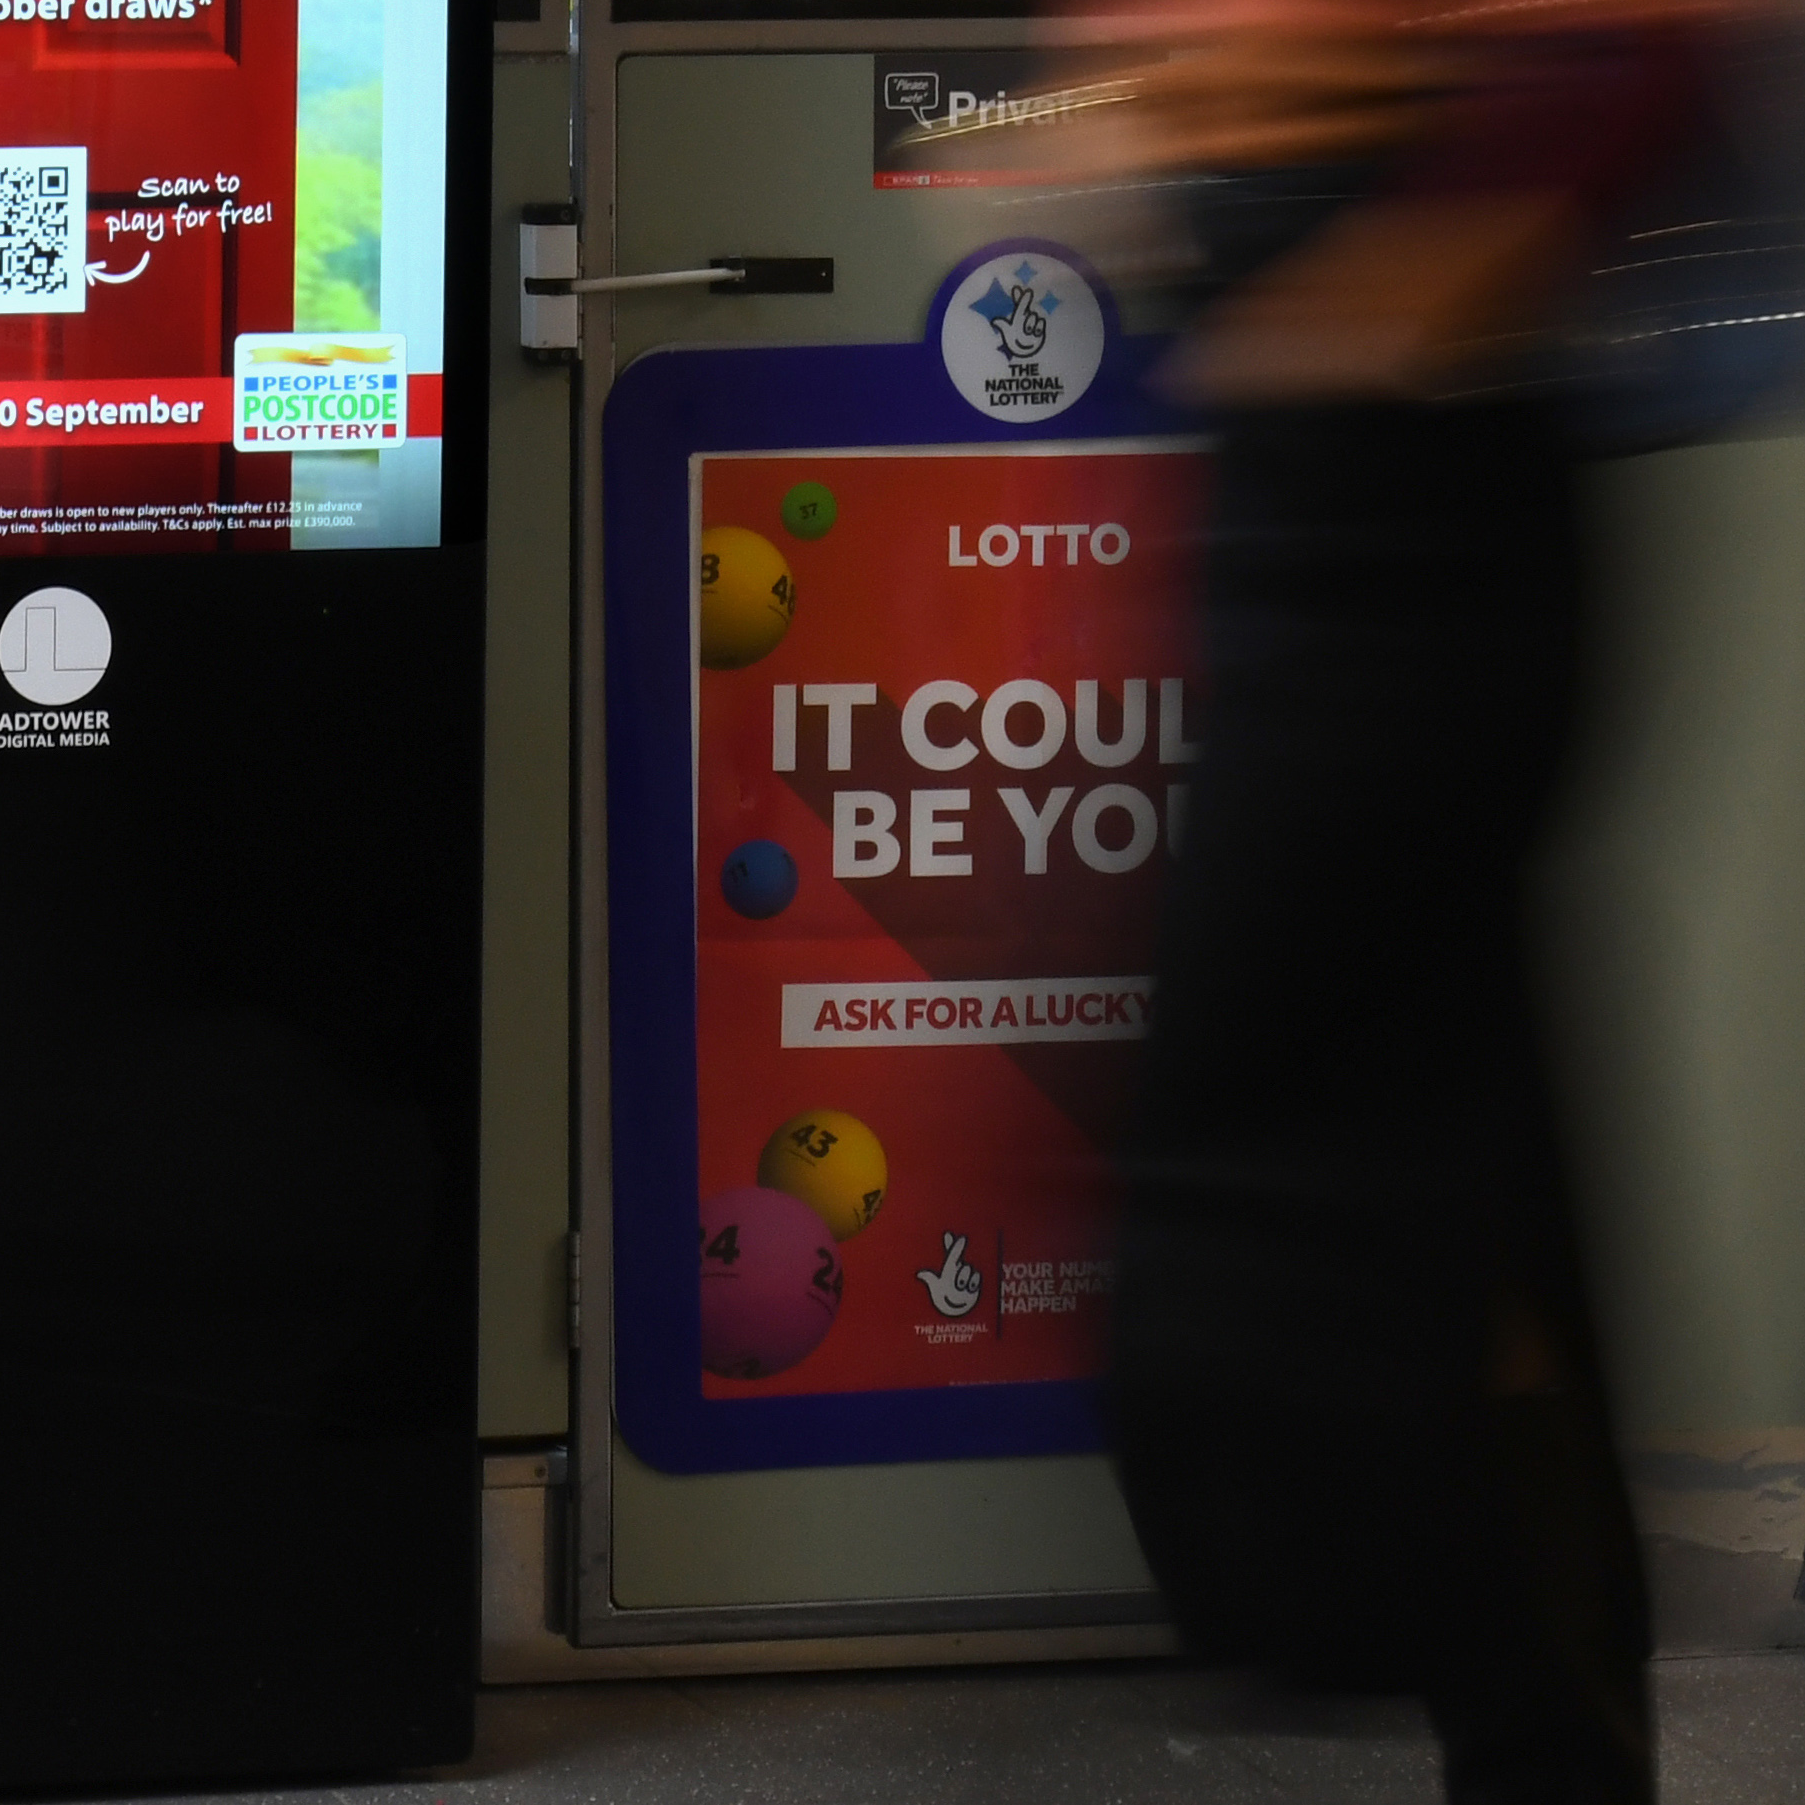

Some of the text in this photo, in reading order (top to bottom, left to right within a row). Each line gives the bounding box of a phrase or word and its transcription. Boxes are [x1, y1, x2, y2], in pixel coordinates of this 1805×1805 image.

[139, 170, 240, 199] Scan to
[106, 200, 273, 242] play for free!
[1009, 363, 1040, 378] THE
[262, 373, 380, 392] PEOPLE'S
[984, 376, 1064, 393] NATIONAL
[243, 393, 398, 423] POSTCODE
[989, 391, 1060, 407] LOTTERY
[26, 396, 204, 435] September
[262, 424, 379, 442] LOTTERY
[20, 506, 53, 519] draws
[55, 506, 64, 518] is
[66, 507, 95, 521] open
[96, 506, 107, 518] to
[112, 506, 135, 517] new
[137, 504, 177, 519] players
[179, 503, 205, 518] only.
[208, 501, 263, 515] Thereafter
[266, 501, 301, 514] £12.25
[304, 500, 314, 512] in
[317, 499, 362, 512] advance
[10, 521, 38, 534] time.
[41, 520, 82, 536] Subject
[84, 520, 96, 532] to
[99, 518, 160, 534] availability.
[163, 518, 188, 531] T&Cs
[191, 518, 225, 535] apply.
[227, 517, 246, 530] Est.
[248, 518, 272, 530] max
[273, 516, 301, 532] prize
[948, 522, 1131, 567] LOTTO
[772, 682, 878, 773] IT
[60, 732, 111, 748] MEDIA
[833, 789, 973, 879] BE
[814, 997, 897, 1033] ASK
[906, 997, 984, 1031] FOR
[989, 996, 1019, 1028] A
[790, 1124, 839, 1159] 43
[1002, 1262, 1054, 1279] YOUR
[1001, 1279, 1055, 1297] MAKE
[1000, 1295, 1077, 1315] HAPPEN
[915, 1323, 988, 1336] THE NATIONAL
[928, 1334, 974, 1345] LOTTERY
